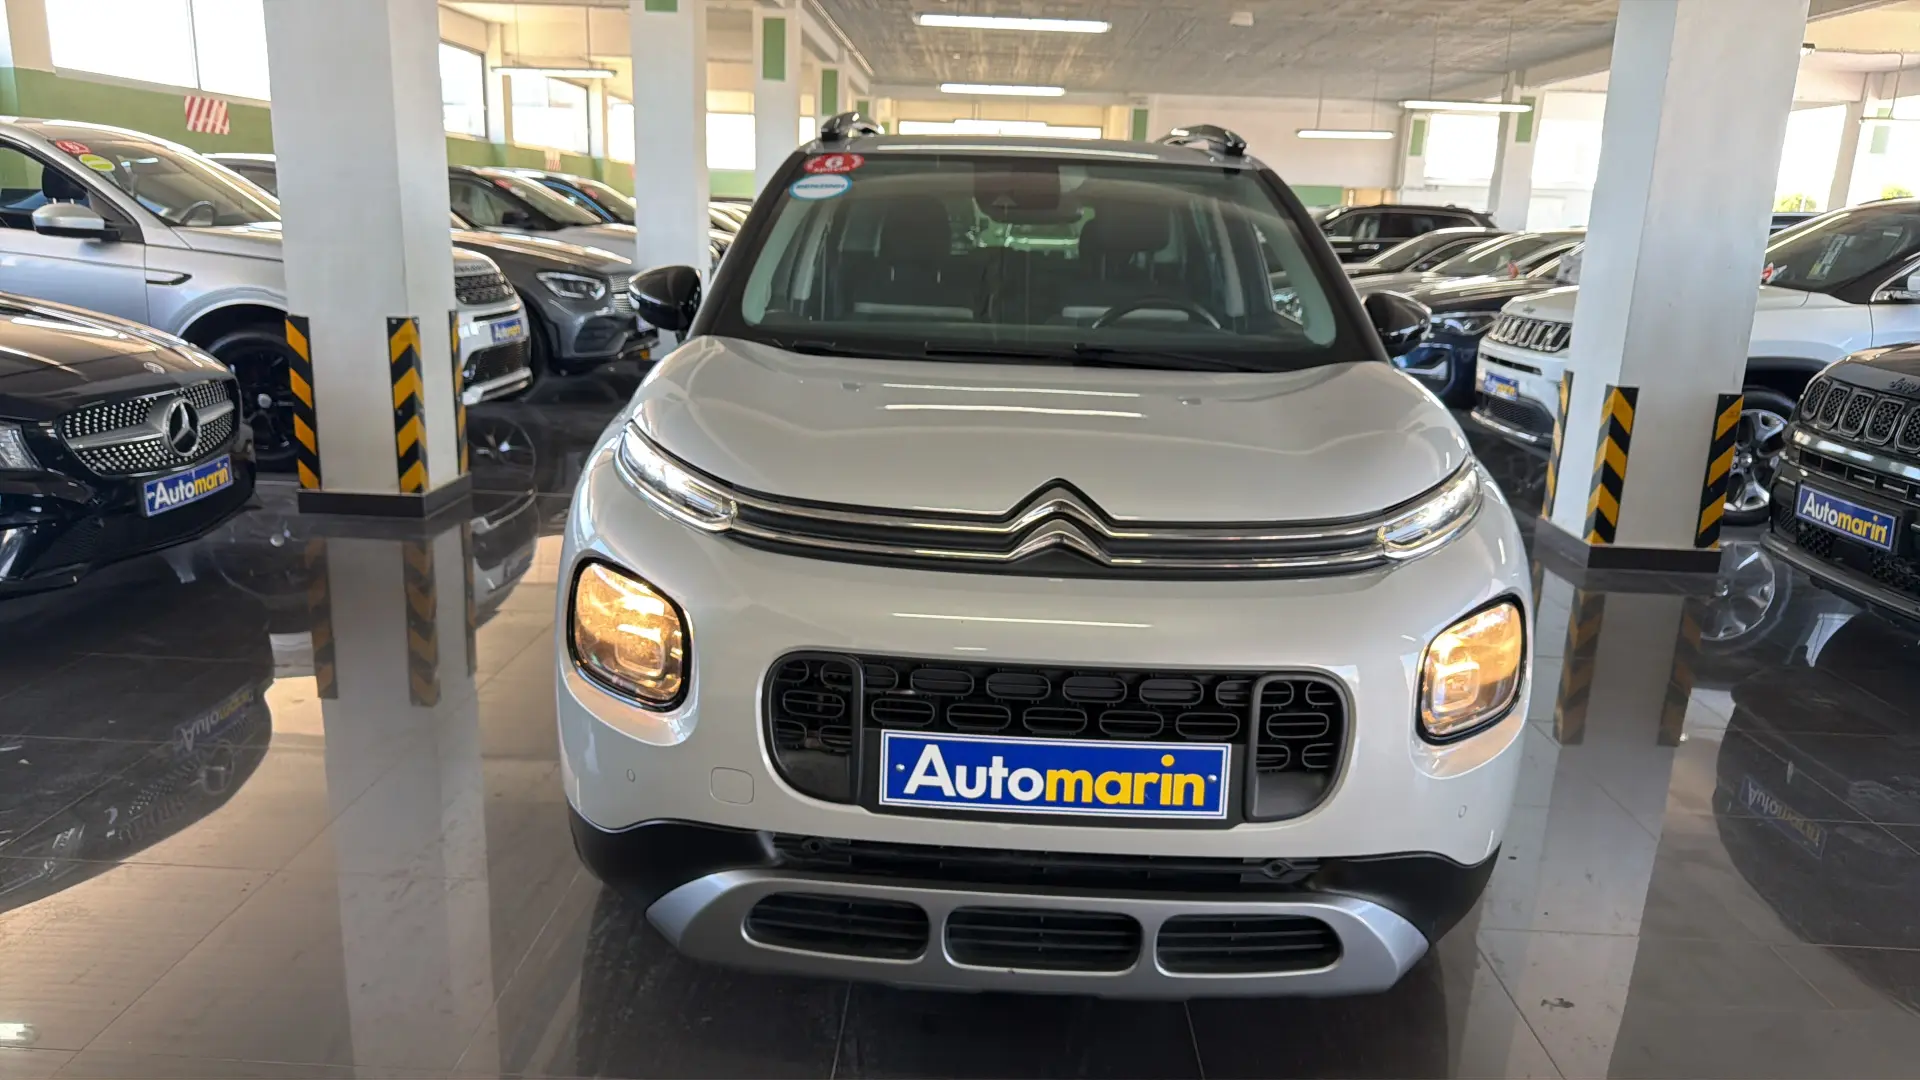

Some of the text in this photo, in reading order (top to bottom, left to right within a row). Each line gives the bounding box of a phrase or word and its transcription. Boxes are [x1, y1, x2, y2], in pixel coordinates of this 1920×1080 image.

[154, 462, 229, 510] Automarin
[1802, 491, 1888, 544] Automarin
[903, 744, 1205, 806] Automarin
